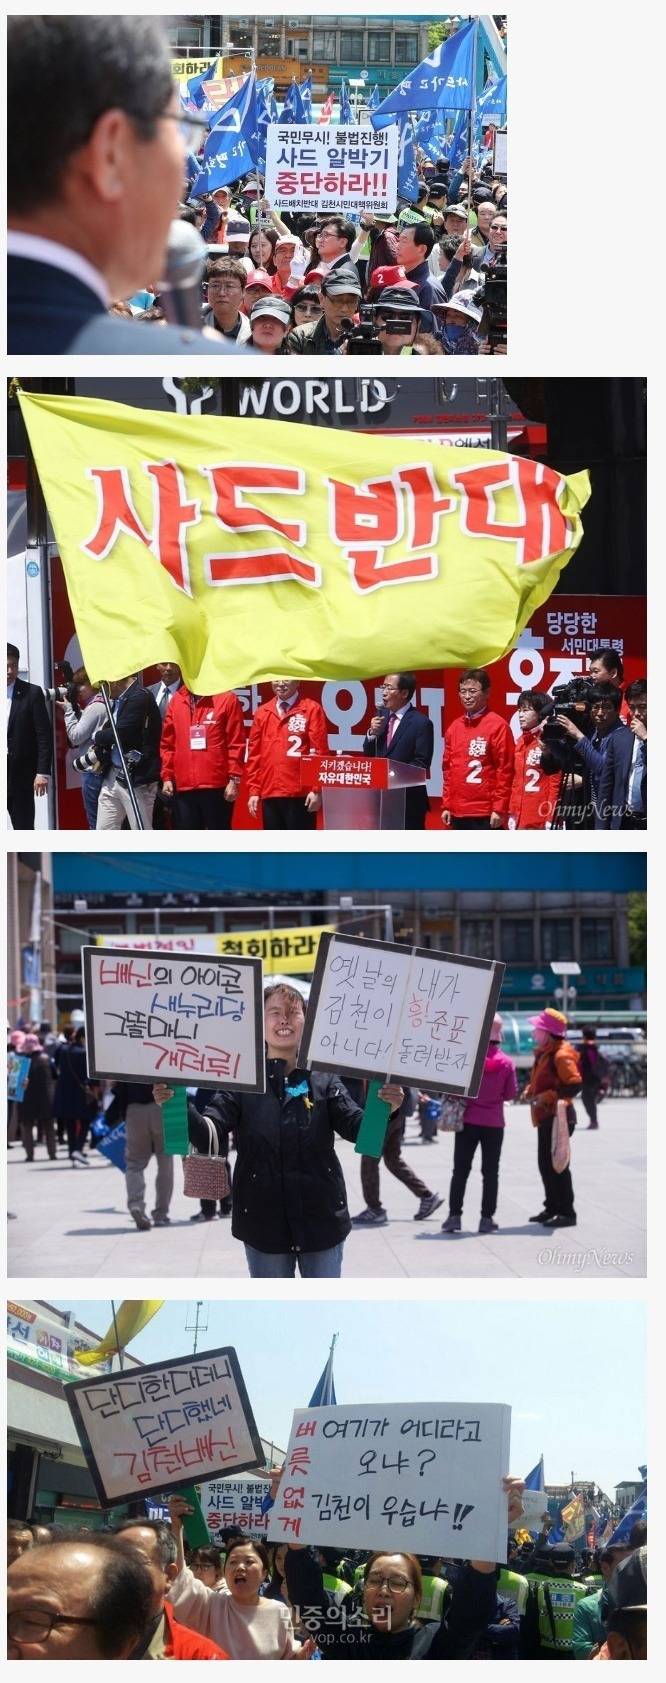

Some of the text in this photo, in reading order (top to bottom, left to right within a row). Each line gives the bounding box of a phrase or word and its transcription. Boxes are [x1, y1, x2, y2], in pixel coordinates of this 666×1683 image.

[278, 131, 330, 145] 국민무시!
[335, 131, 388, 146] 불법진행!
[276, 147, 389, 169] 사드 알박기
[276, 171, 387, 196] 중단하라!!
[273, 199, 318, 208] 사드배치반대
[239, 379, 388, 416] WORLD
[81, 456, 573, 598] 사드반대
[547, 612, 598, 635] 당당한
[287, 735, 302, 757] 2
[319, 772, 372, 785] 자유대한민국
[320, 760, 372, 773] 지키겠습니다!
[466, 760, 483, 784] 2
[524, 768, 541, 792] 2
[100, 960, 244, 994] 배신의 아이콘
[329, 955, 398, 995] 옛날의
[417, 967, 461, 1004] 내가
[151, 992, 245, 1022] 새누리당
[324, 993, 393, 1031] 김천이
[398, 1038, 470, 1072] 돌려받자
[82, 1359, 232, 1419] 단디한다더니
[133, 1394, 232, 1447] 단디했네
[322, 1418, 482, 1442] 여기가 어디라고
[113, 1426, 238, 1484] 김천배신
[208, 1483, 243, 1494] 국민무시!
[208, 1495, 235, 1510] 사드
[311, 1493, 370, 1521] 김천이
